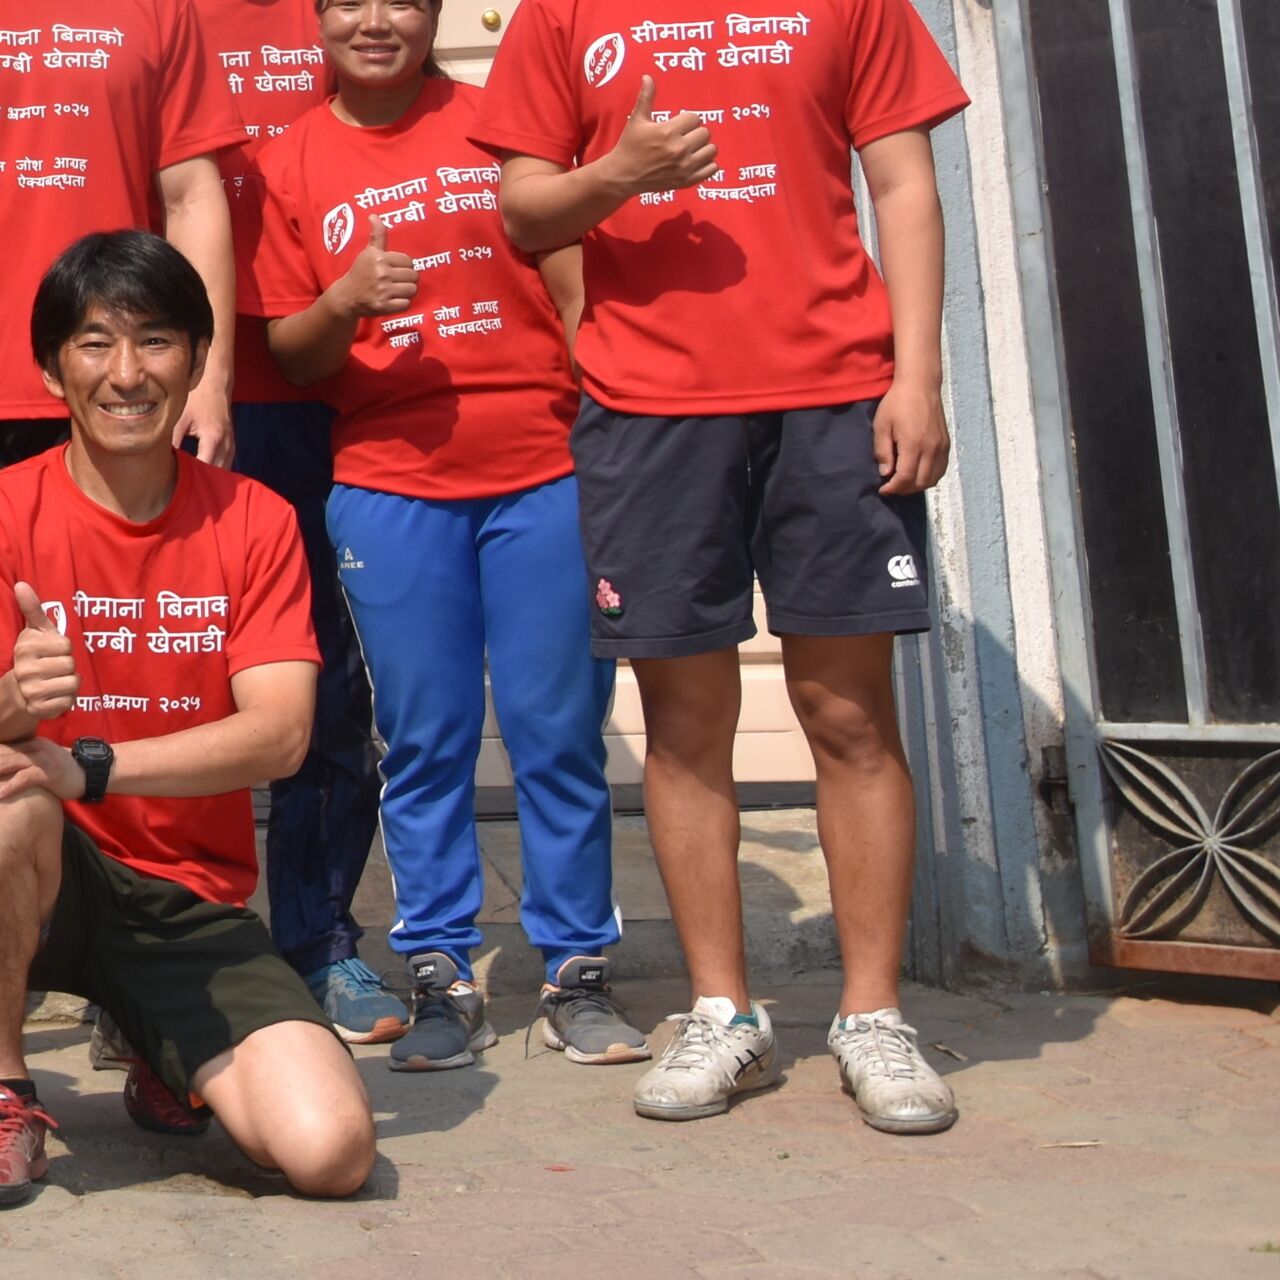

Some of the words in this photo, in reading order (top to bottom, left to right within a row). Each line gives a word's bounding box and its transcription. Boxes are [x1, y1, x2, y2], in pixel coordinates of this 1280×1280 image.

[51, 23, 125, 47] बिनाको
[630, 20, 715, 44] सीमाना
[725, 11, 811, 36] बिनाको
[42, 47, 111, 69] खेलाडी
[260, 44, 327, 66] बिनाको
[595, 49, 612, 76] RWB
[653, 46, 707, 72] रग्बी
[716, 40, 794, 67] खेलाडी
[253, 70, 314, 92] खेलाडी
[7, 105, 47, 120] भ्रमण
[53, 103, 90, 117] २०२५
[732, 104, 770, 120] २०२५
[15, 156, 44, 172] जोश
[53, 157, 88, 172] आग्रह
[739, 164, 777, 180] आग्रह
[354, 177, 428, 209] सीमाना
[436, 162, 502, 187] बिनाको
[380, 203, 426, 230] रग्बी
[435, 188, 497, 214] खेलाडी
[412, 251, 451, 272] भ्रमण
[459, 246, 492, 261] २०२५
[381, 313, 424, 332] सम्मान
[433, 306, 460, 321] जोश
[472, 301, 498, 314] आग्रह
[389, 332, 419, 348] साहस
[83, 626, 137, 653] रग्बी
[146, 624, 226, 654] खेलाडी
[102, 694, 149, 712] भ्रमण
[159, 696, 200, 712] २०२५
